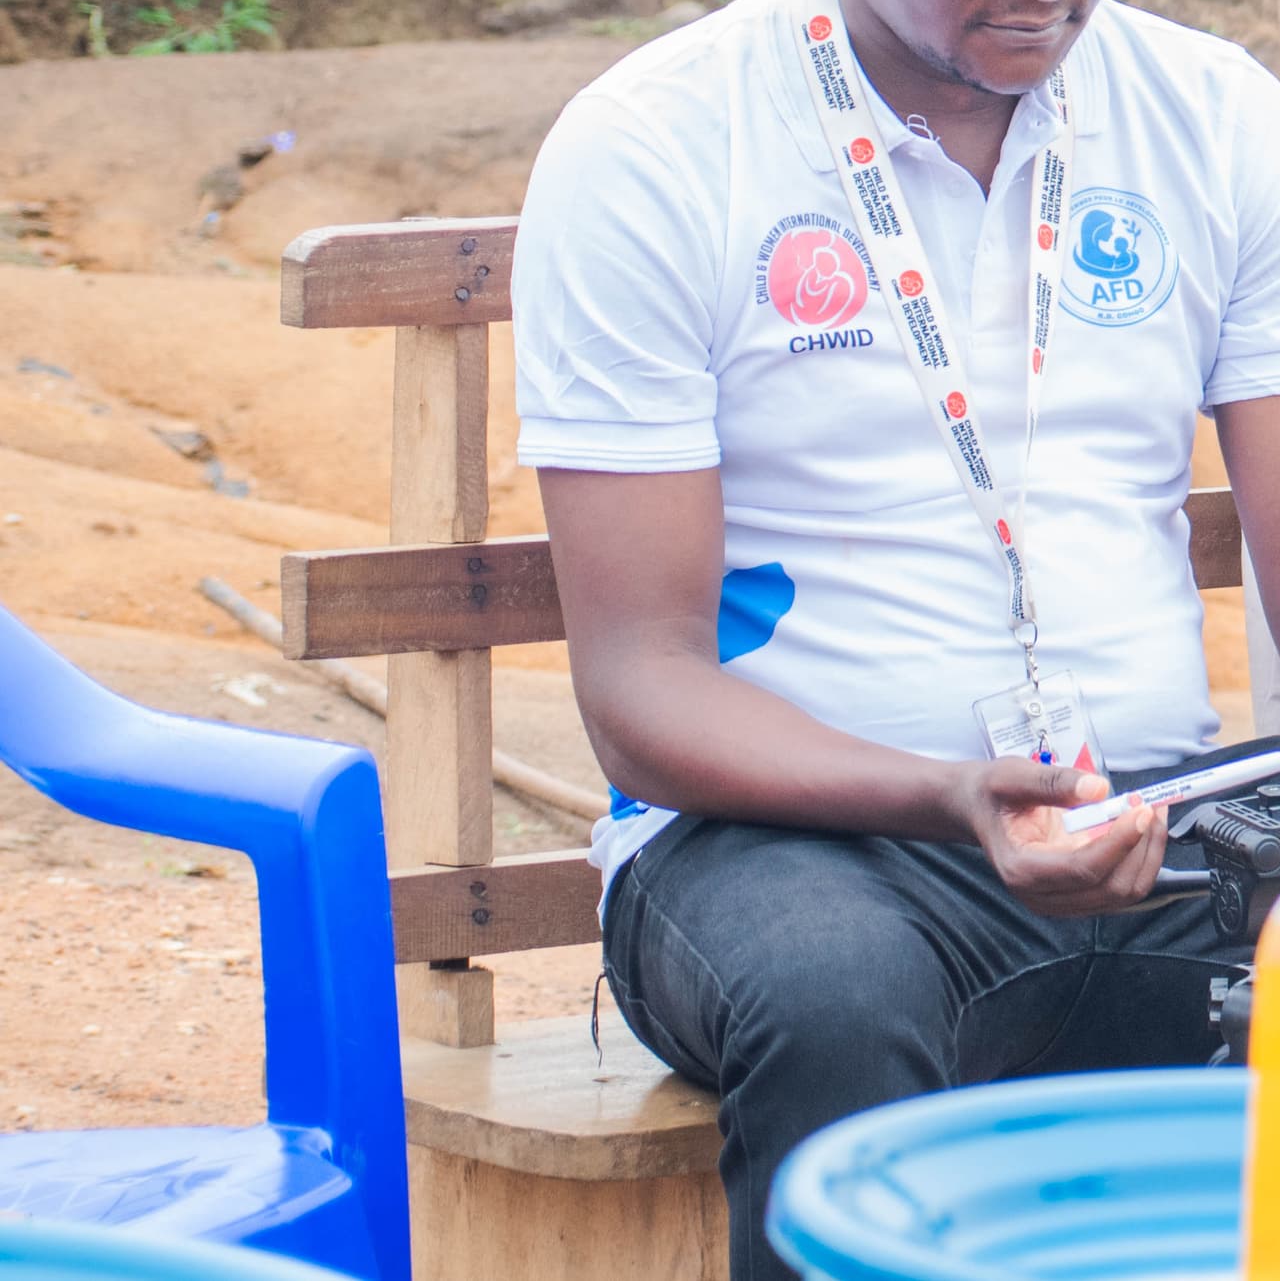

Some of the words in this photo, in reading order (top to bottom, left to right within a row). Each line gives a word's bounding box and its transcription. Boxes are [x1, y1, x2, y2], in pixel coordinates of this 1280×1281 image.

[809, 47, 837, 109] DEVELOPMENT
[819, 44, 847, 112] INTERNATIONAL
[826, 40, 840, 66] CHILD
[839, 76, 856, 110] WOMEN
[777, 213, 842, 233] INTERNATIONAL
[853, 172, 883, 236] DEVELOPMENT
[861, 169, 893, 238] INTERNATIONAL
[870, 166, 885, 193] CHILD
[884, 203, 903, 237] WOMEN
[756, 265, 768, 273] &
[757, 227, 782, 261] WOMEN
[842, 228, 881, 292] DEVELOPMENT
[756, 275, 769, 305] CHILD
[1091, 278, 1144, 305] AFD
[789, 328, 874, 354] CHWID
[902, 302, 933, 367] DEVELOPMENT
[910, 299, 942, 370] INTERNATIONAL
[919, 296, 934, 323] CHILD
[933, 332, 950, 368] WOMEN
[950, 425, 984, 489] DEVELOPMENT
[958, 422, 989, 493] INTERNATIONAL
[964, 419, 978, 446] CHILD
[978, 456, 993, 491] WOMEN
